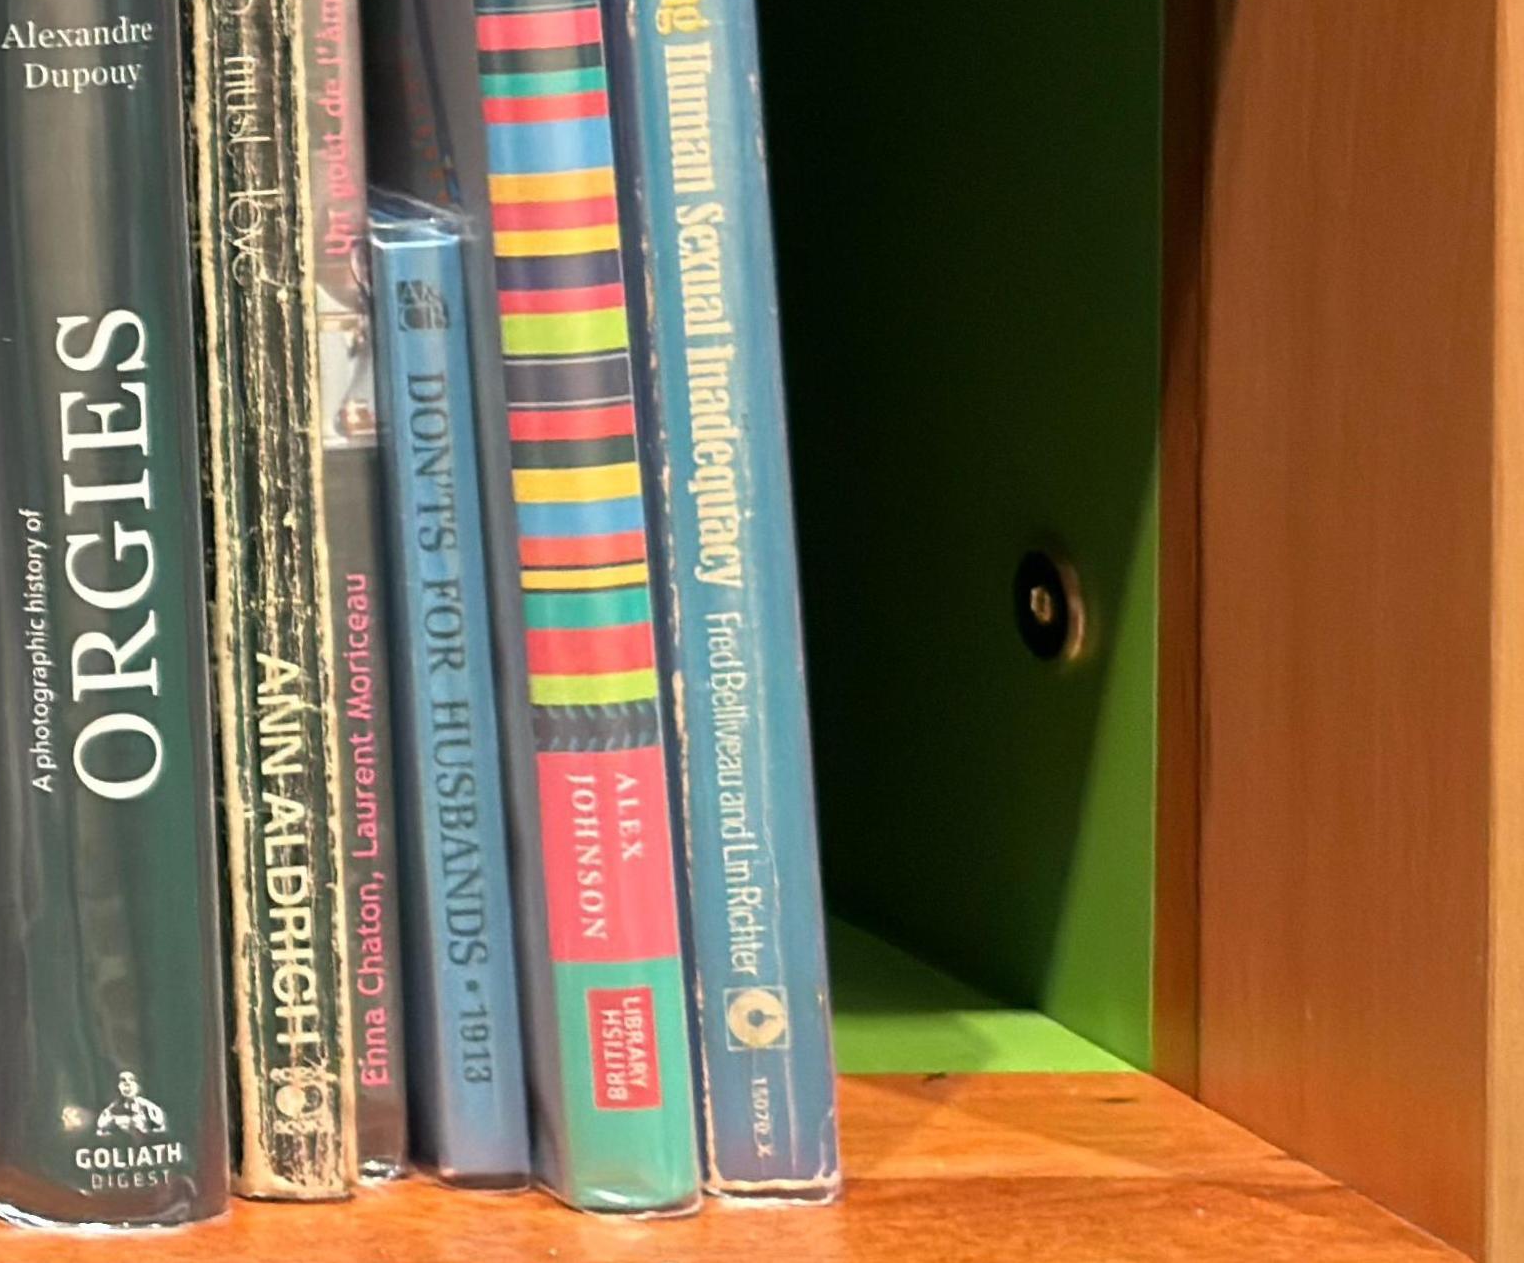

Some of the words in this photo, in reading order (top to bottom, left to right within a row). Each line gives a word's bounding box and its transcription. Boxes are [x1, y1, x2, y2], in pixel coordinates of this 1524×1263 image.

[1, 18, 153, 50] Alexandre
[24, 60, 143, 93] Dupouy
[664, 41, 715, 194] Human
[675, 202, 729, 338] Sexual
[686, 344, 743, 591] Inadequacy
[20, 510, 41, 534] of
[56, 310, 162, 799] ORGIES
[23, 540, 51, 624] history
[420, 571, 467, 674] FOR
[347, 574, 373, 720] Moriceau
[705, 612, 740, 660] Fred
[29, 630, 55, 766] photographic
[31, 774, 53, 792] A
[350, 740, 376, 860] Laurent
[615, 771, 641, 861] ALEX
[723, 791, 755, 835] and
[433, 699, 489, 966] HUSBANDS
[567, 772, 607, 940] JOHNSON
[729, 888, 761, 979] Richter
[359, 1006, 390, 1086] Enna
[456, 1002, 492, 1086] 1913
[601, 1010, 627, 1100] BRITISH
[625, 997, 647, 1088] LIBRARY
[76, 1143, 182, 1169] GOLIATH
